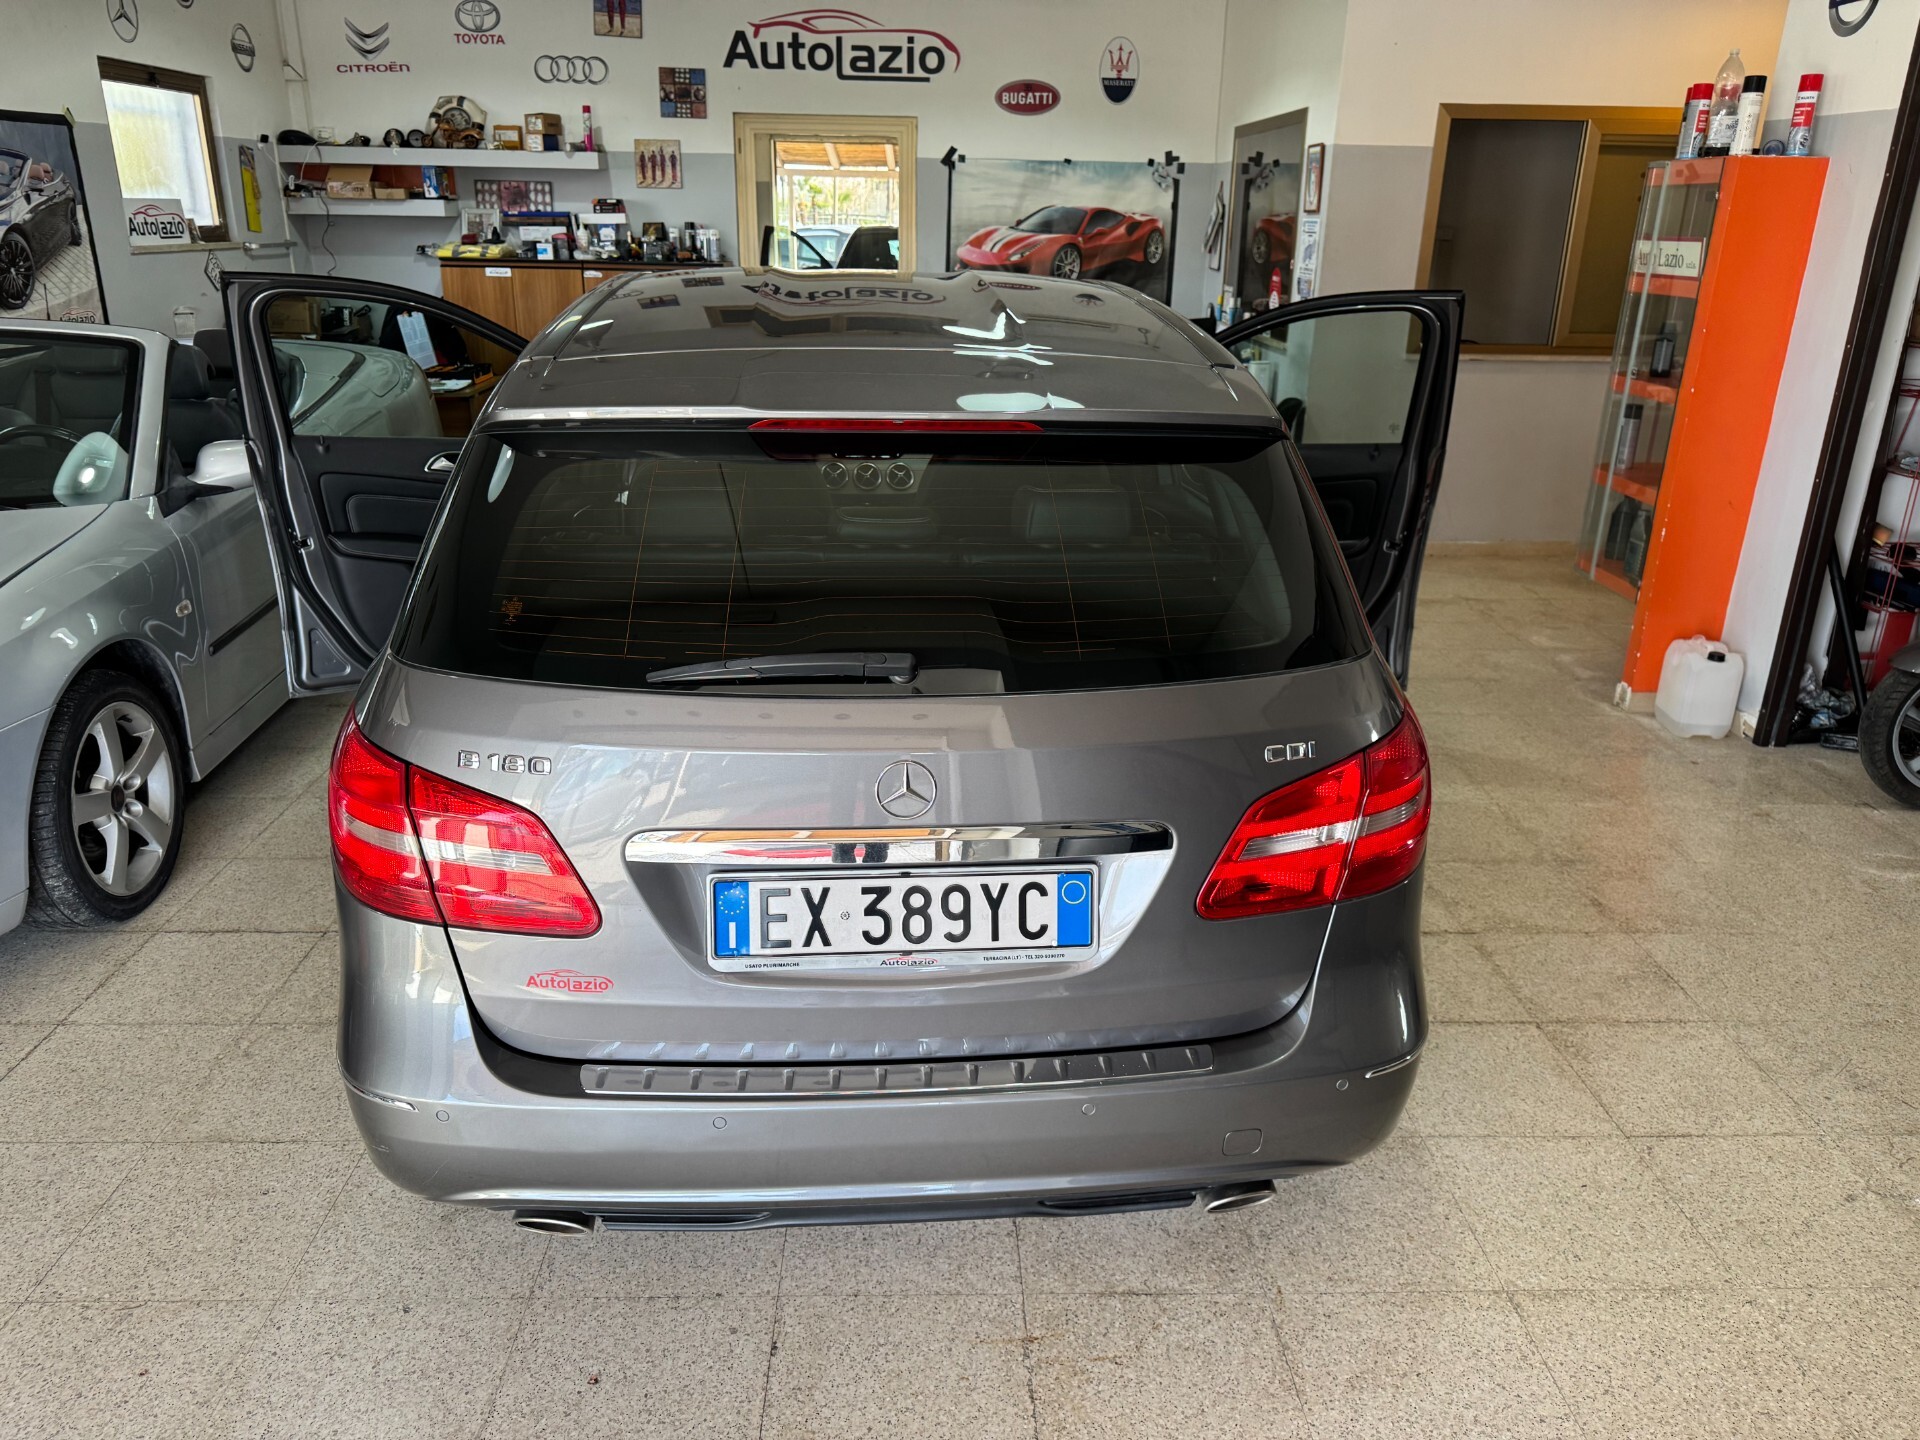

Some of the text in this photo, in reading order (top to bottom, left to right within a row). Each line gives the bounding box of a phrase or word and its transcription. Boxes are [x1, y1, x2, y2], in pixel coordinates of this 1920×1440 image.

[453, 33, 506, 45] TOYOTA
[1001, 92, 1053, 105] BUGATTI
[1658, 247, 1685, 268] Lazio
[1265, 741, 1316, 763] CDI
[457, 750, 553, 776] B 180
[759, 886, 832, 949] EX
[860, 880, 1049, 946] 389YC
